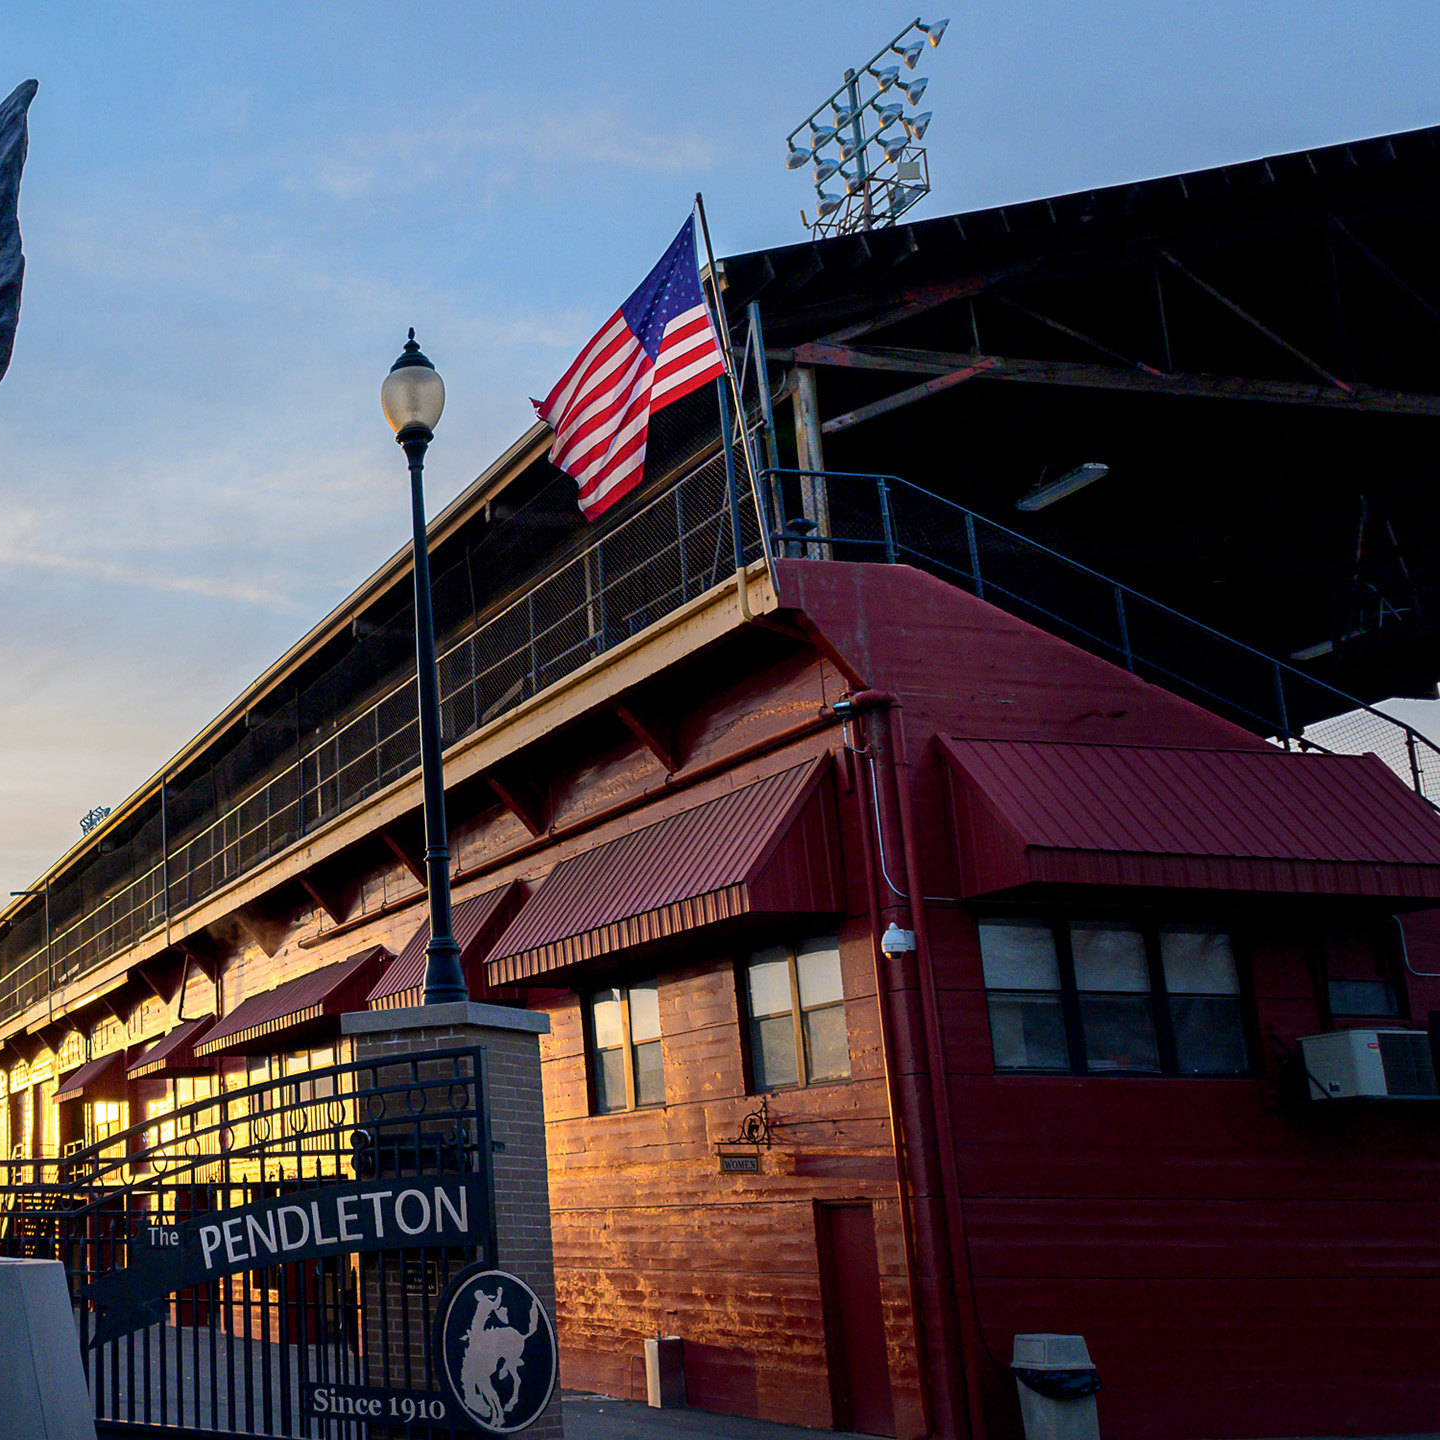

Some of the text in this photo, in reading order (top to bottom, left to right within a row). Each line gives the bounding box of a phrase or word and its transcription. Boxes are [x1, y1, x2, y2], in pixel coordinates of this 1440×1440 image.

[724, 1158, 756, 1170] WOMEN
[147, 1185, 469, 1270] The PENDLETON
[313, 1387, 446, 1423] Since 1910
